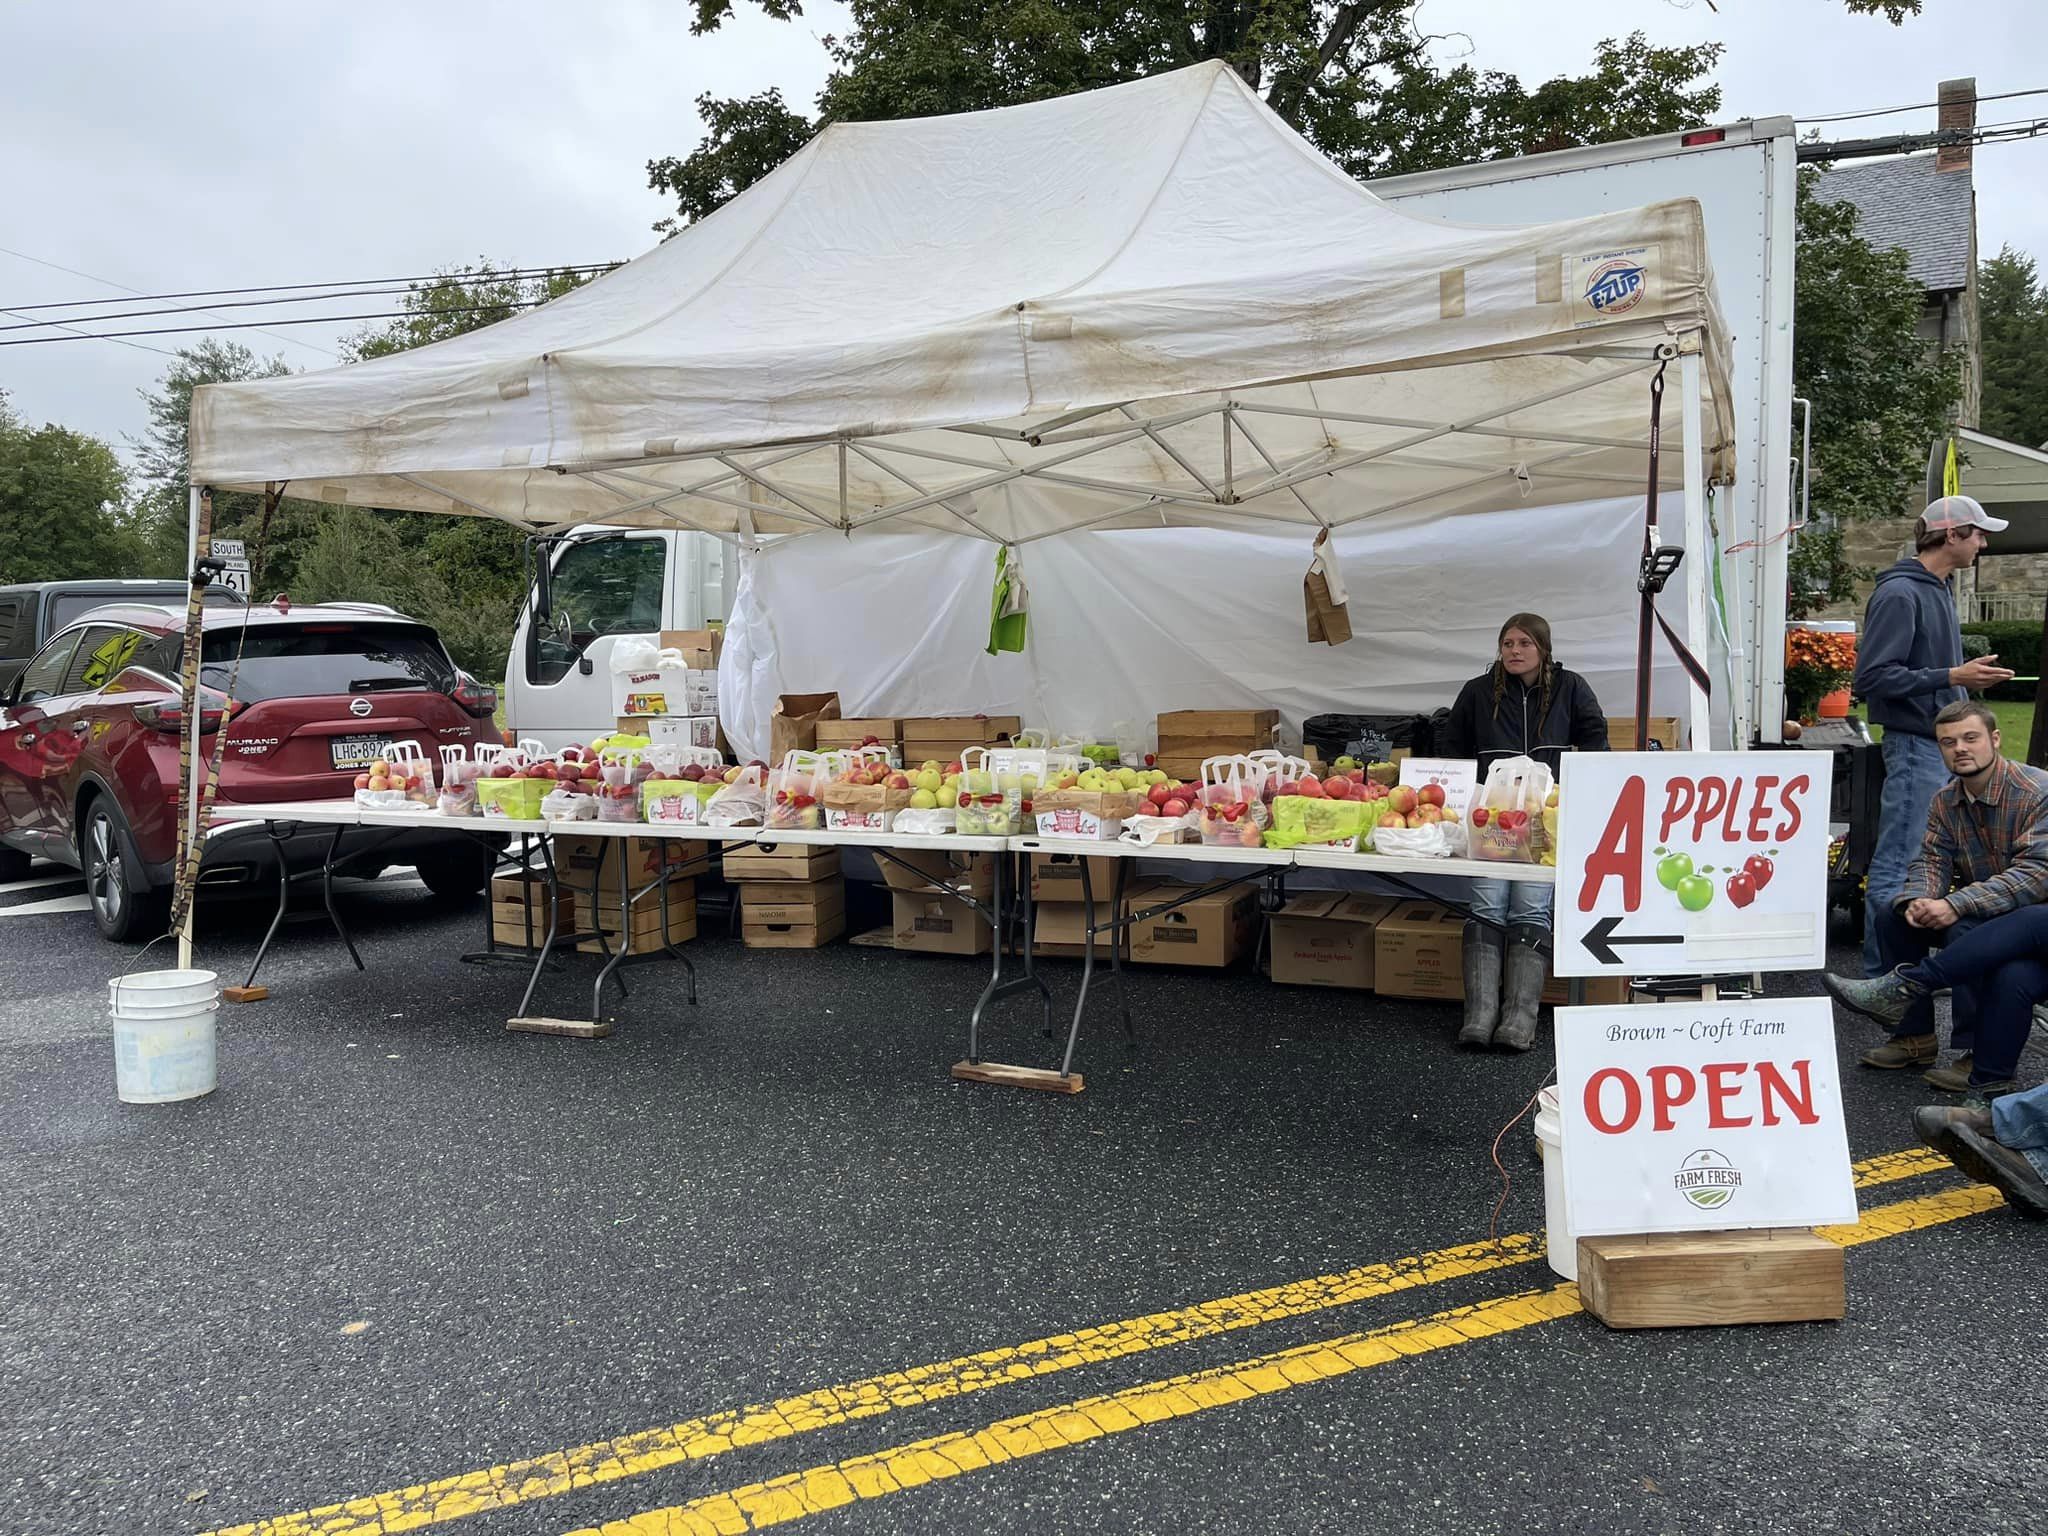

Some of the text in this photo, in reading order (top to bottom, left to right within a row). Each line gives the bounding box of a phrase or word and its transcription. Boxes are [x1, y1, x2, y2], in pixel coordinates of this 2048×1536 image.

[214, 542, 242, 555] SOUTH
[226, 737, 279, 745] MURANO
[1578, 775, 1810, 913] APPLES
[1607, 1024, 1665, 1041] Brown
[1689, 1018, 1734, 1043] Croft
[1740, 1019, 1785, 1036] Farm
[1583, 1060, 1820, 1134] OPEN
[1674, 1170, 1742, 1189] FARM FRESH
